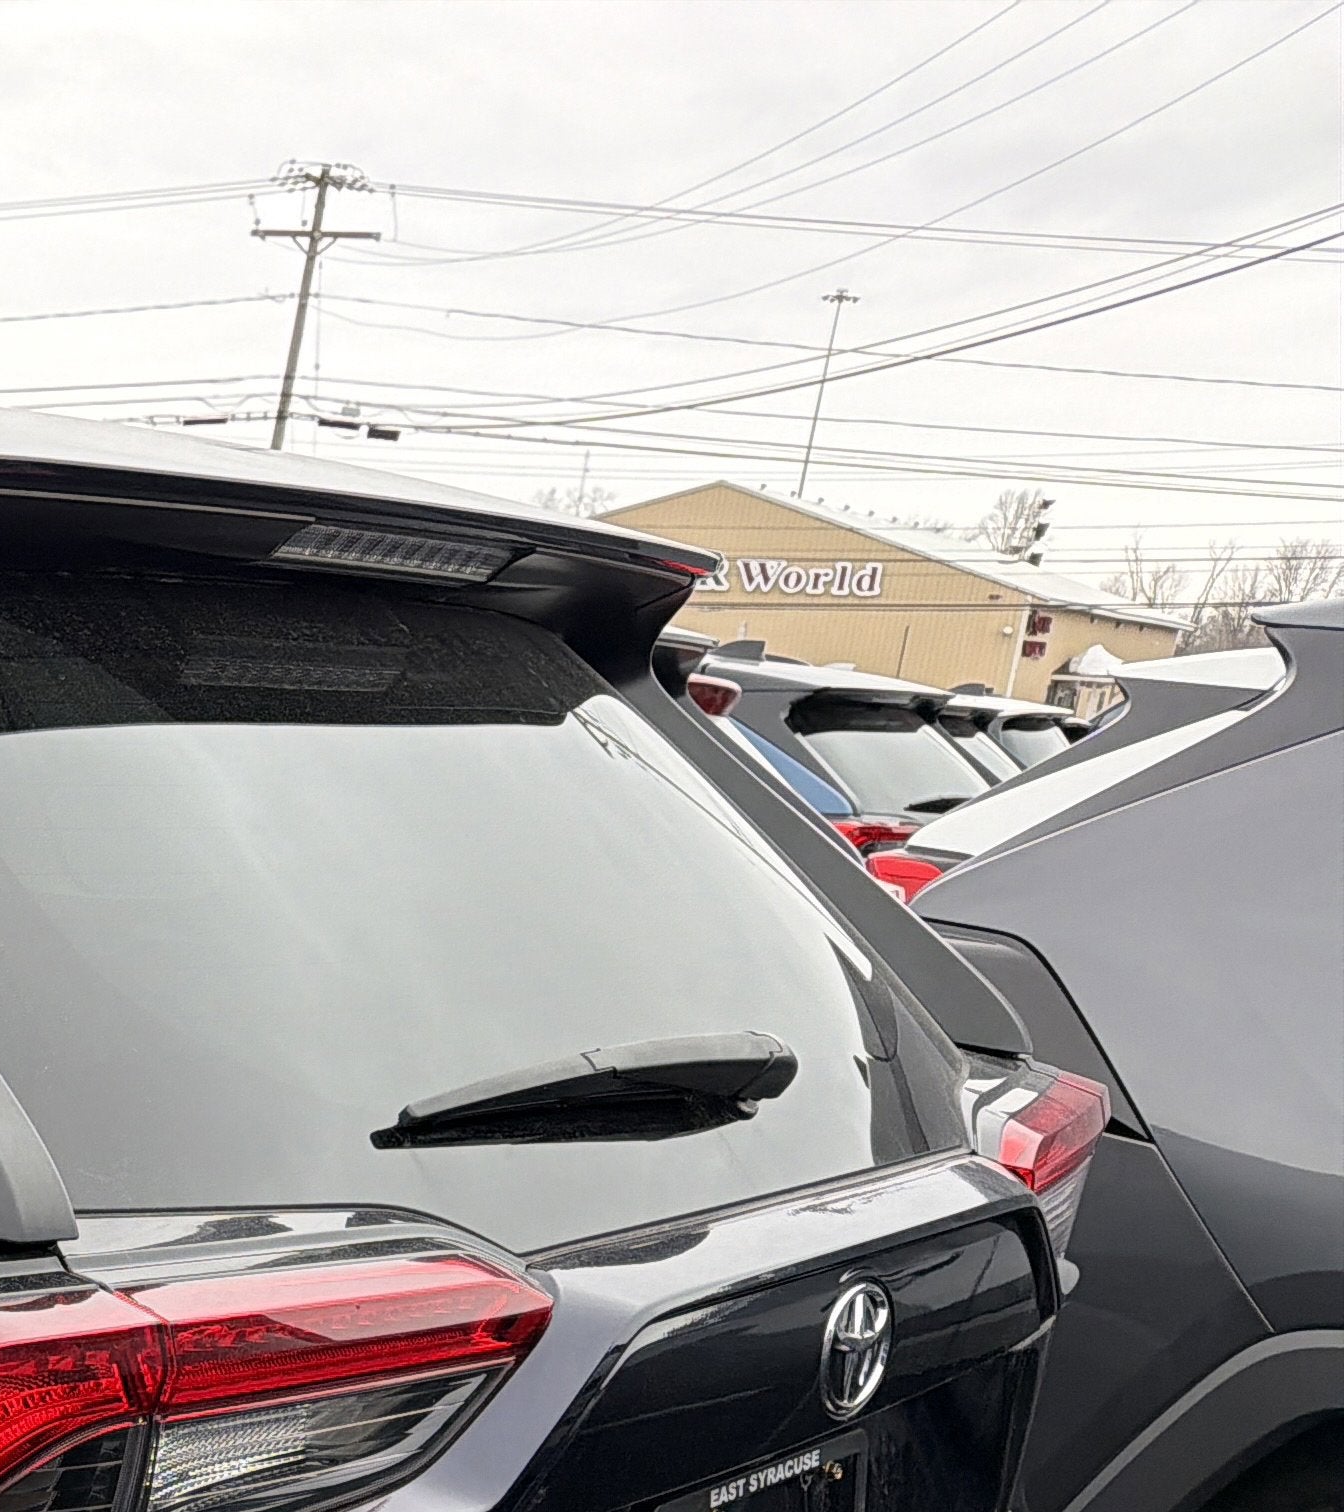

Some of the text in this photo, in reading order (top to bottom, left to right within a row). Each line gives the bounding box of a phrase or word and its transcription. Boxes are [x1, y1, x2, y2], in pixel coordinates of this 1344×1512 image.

[737, 559, 883, 596] World
[710, 1449, 821, 1508] EAST SYRACUSE
